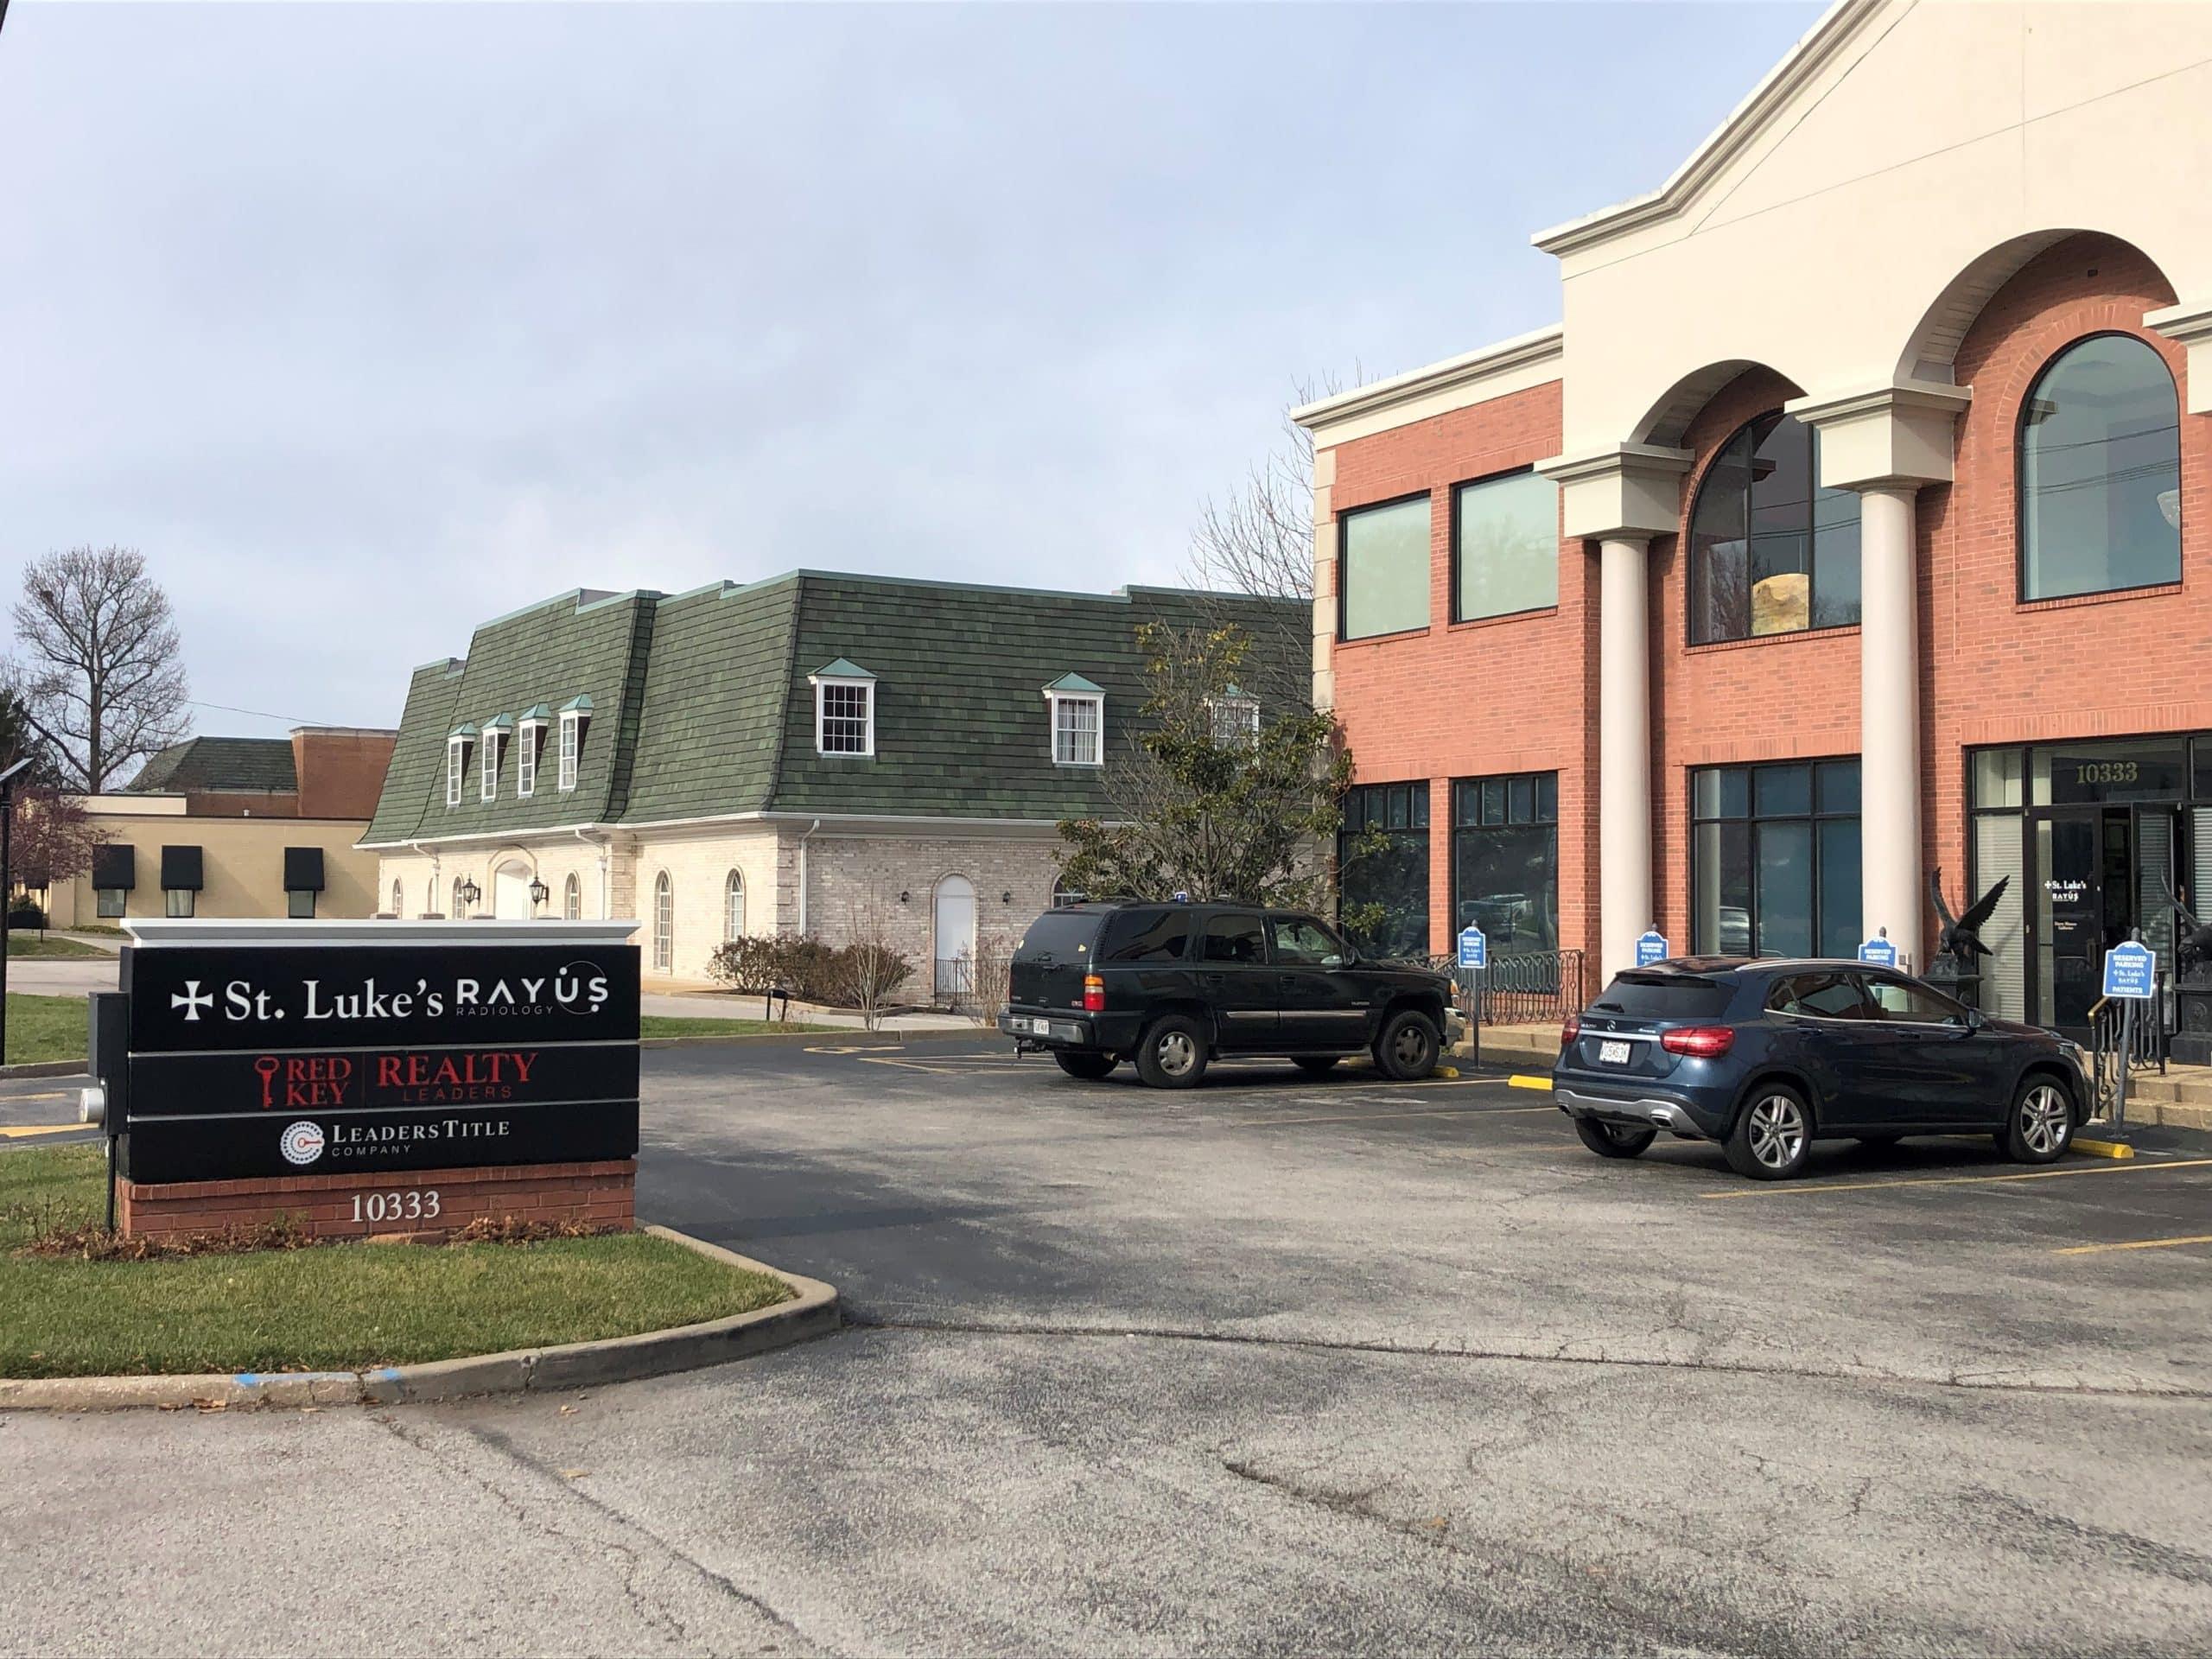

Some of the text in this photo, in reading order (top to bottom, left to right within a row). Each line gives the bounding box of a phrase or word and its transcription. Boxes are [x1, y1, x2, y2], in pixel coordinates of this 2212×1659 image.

[2076, 761, 2138, 784] 10333
[2052, 880, 2087, 889] St. Luke's
[225, 977, 443, 1020] St. Luke's
[456, 1005, 554, 1016] RADIOLOGY
[288, 1057, 352, 1082] RED
[378, 1052, 539, 1087] REALTY
[287, 1080, 350, 1106] KEY
[403, 1085, 514, 1102] LEADERS
[331, 1143, 412, 1157] COMPANY
[350, 1191, 442, 1223] 10333
